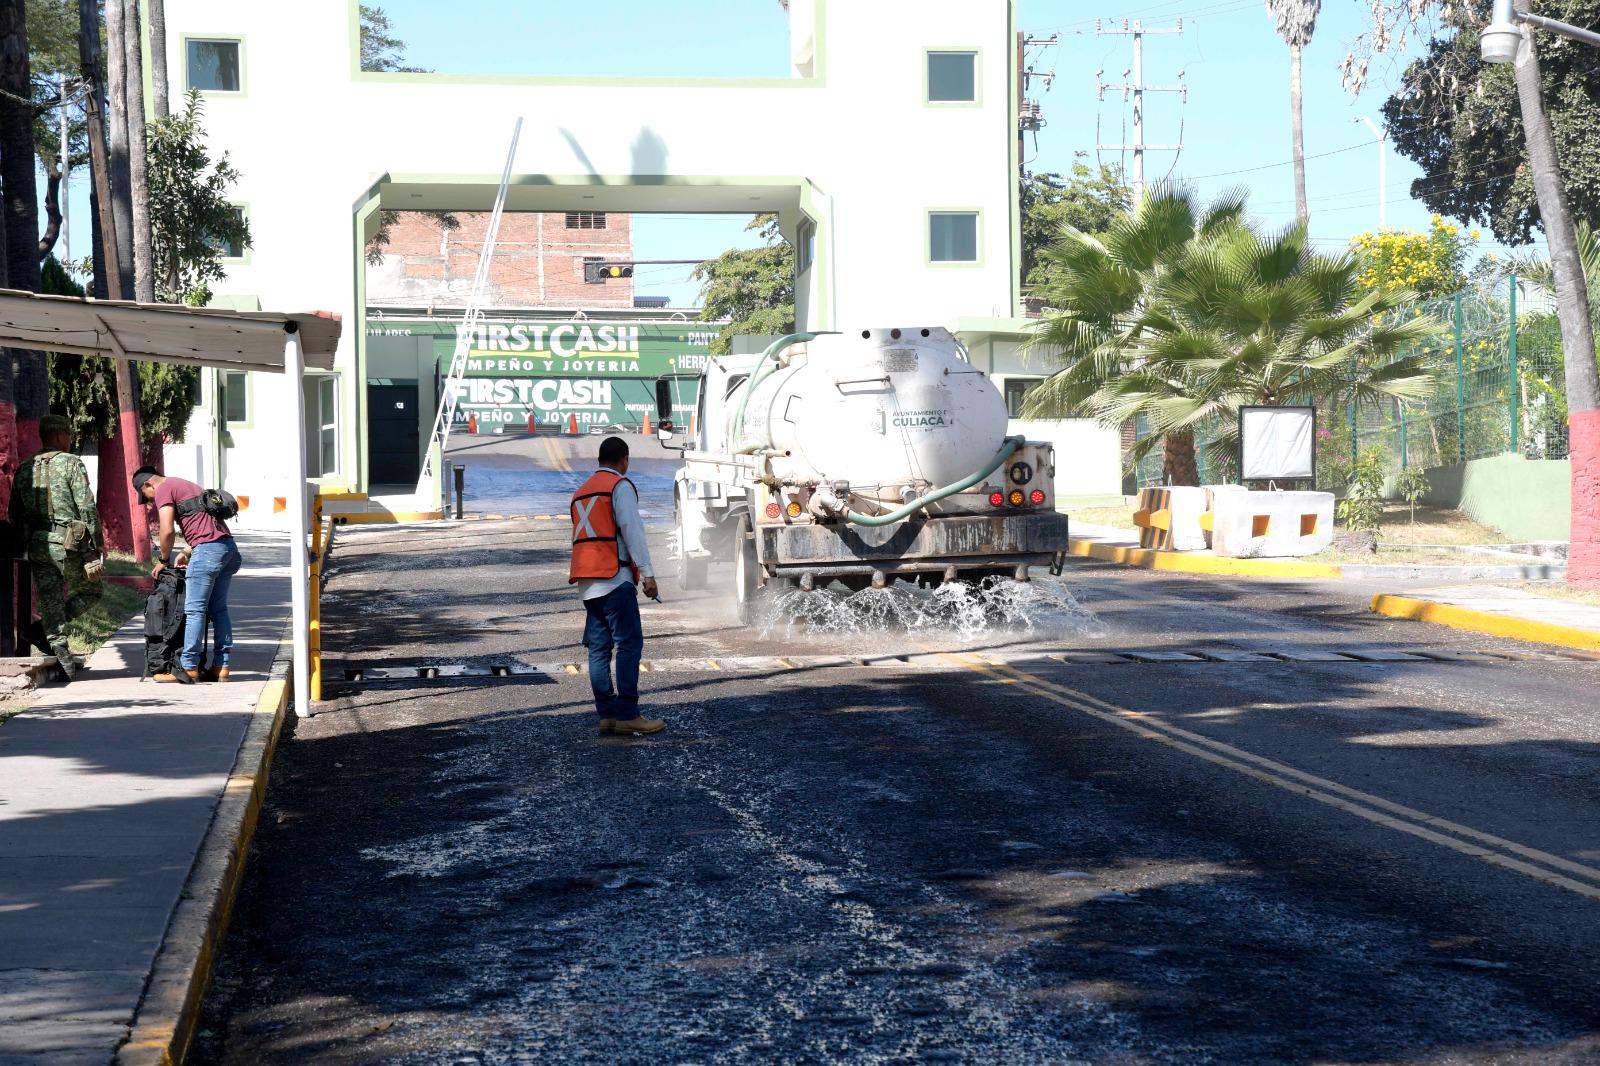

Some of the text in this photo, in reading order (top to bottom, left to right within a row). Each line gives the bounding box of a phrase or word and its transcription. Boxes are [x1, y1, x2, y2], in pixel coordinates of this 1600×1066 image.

[544, 360, 554, 371] Y
[563, 360, 640, 371] JOYERIA
[520, 412, 531, 422] Y
[543, 412, 610, 423] JOYERIA
[892, 409, 942, 417] AYUNTAMIENTO
[892, 416, 953, 427] CULIACA
[1013, 467, 1029, 480] 01
